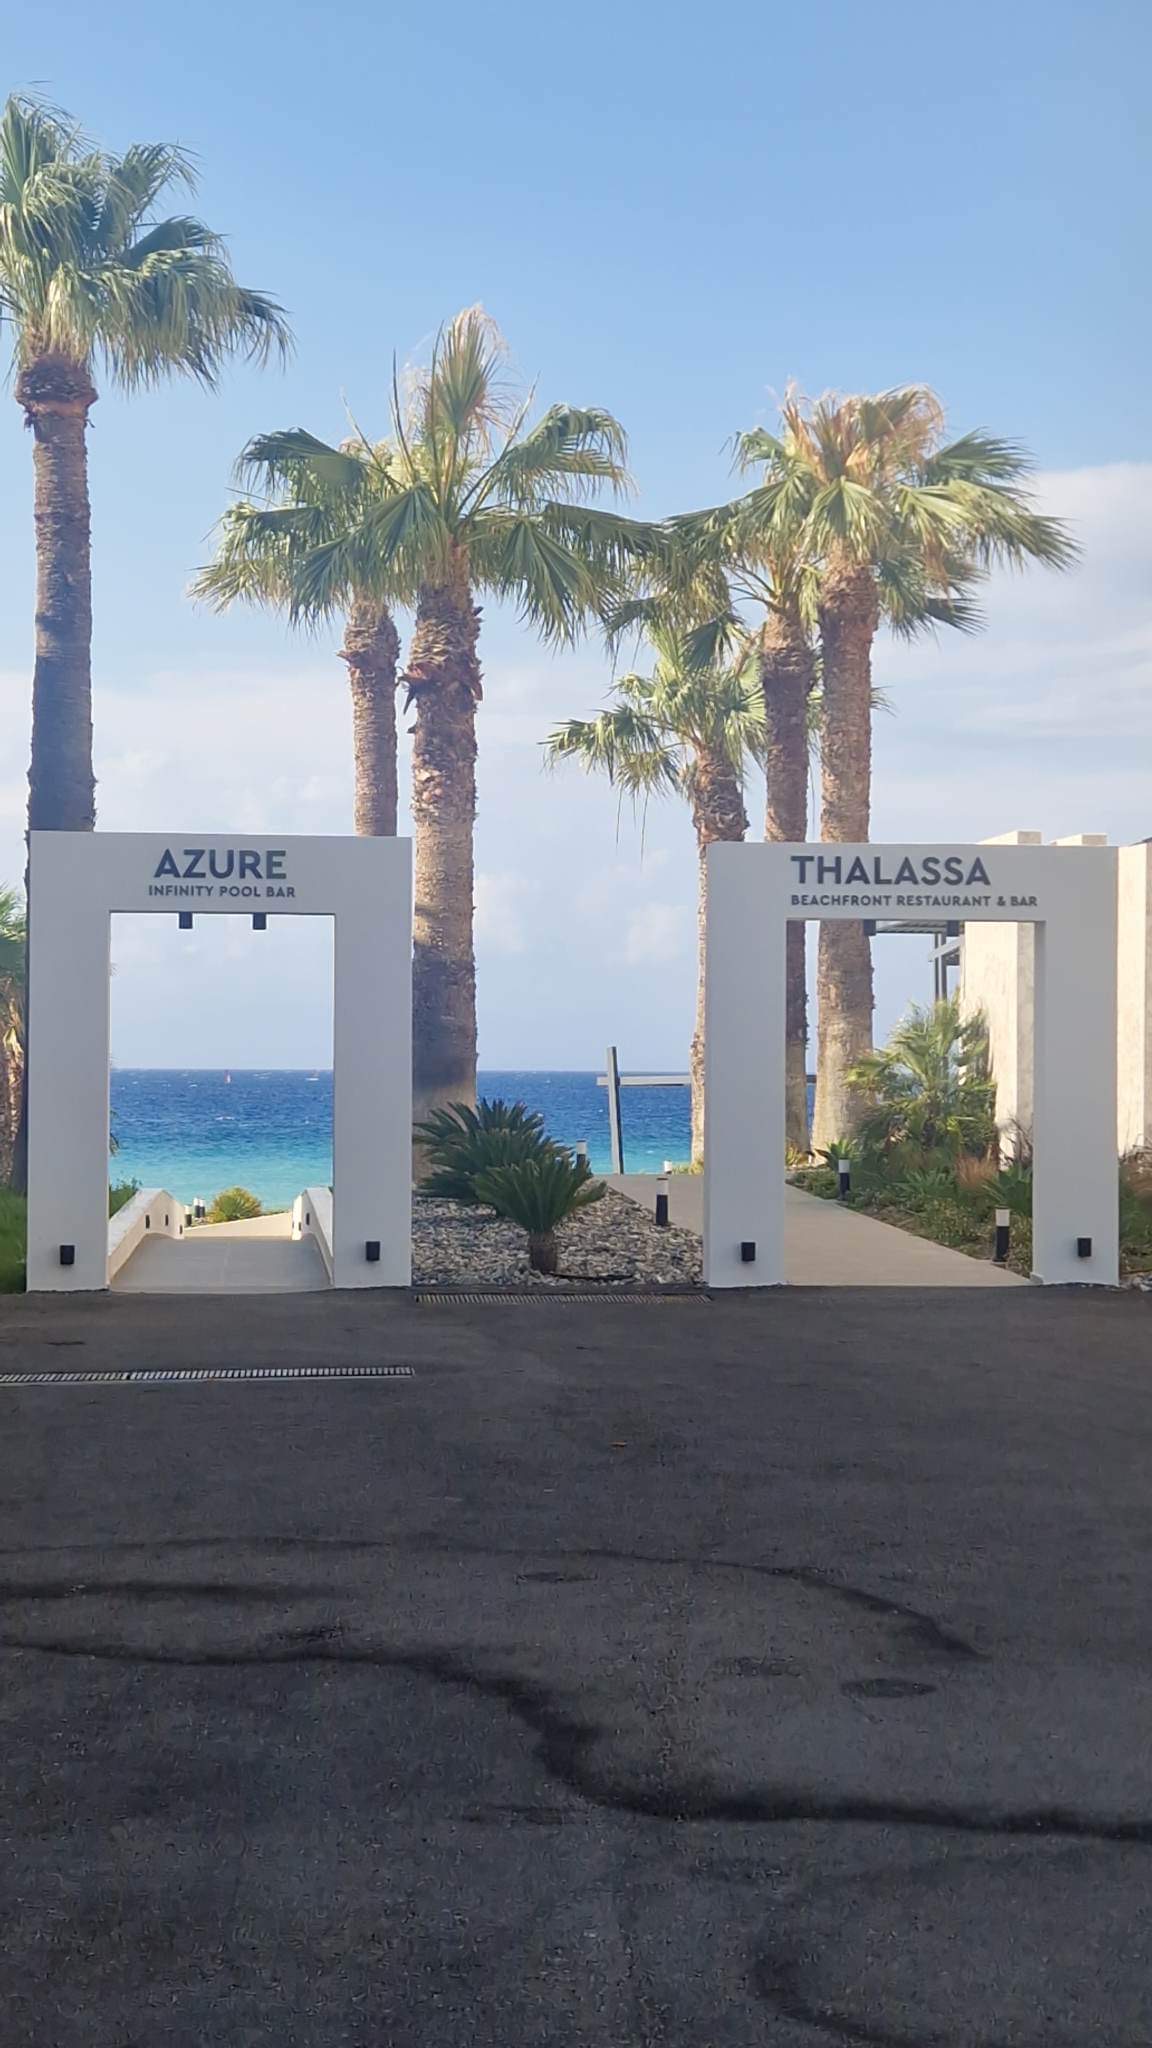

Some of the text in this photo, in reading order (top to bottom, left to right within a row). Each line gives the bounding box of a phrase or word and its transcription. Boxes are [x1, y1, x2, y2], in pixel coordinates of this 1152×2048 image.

[153, 848, 288, 880] AZURE
[790, 855, 992, 886] THALASSA
[148, 884, 296, 899] INFINITY POOL BAR
[790, 894, 1038, 908] BEACHFRONT RESTAURANT & BAR
